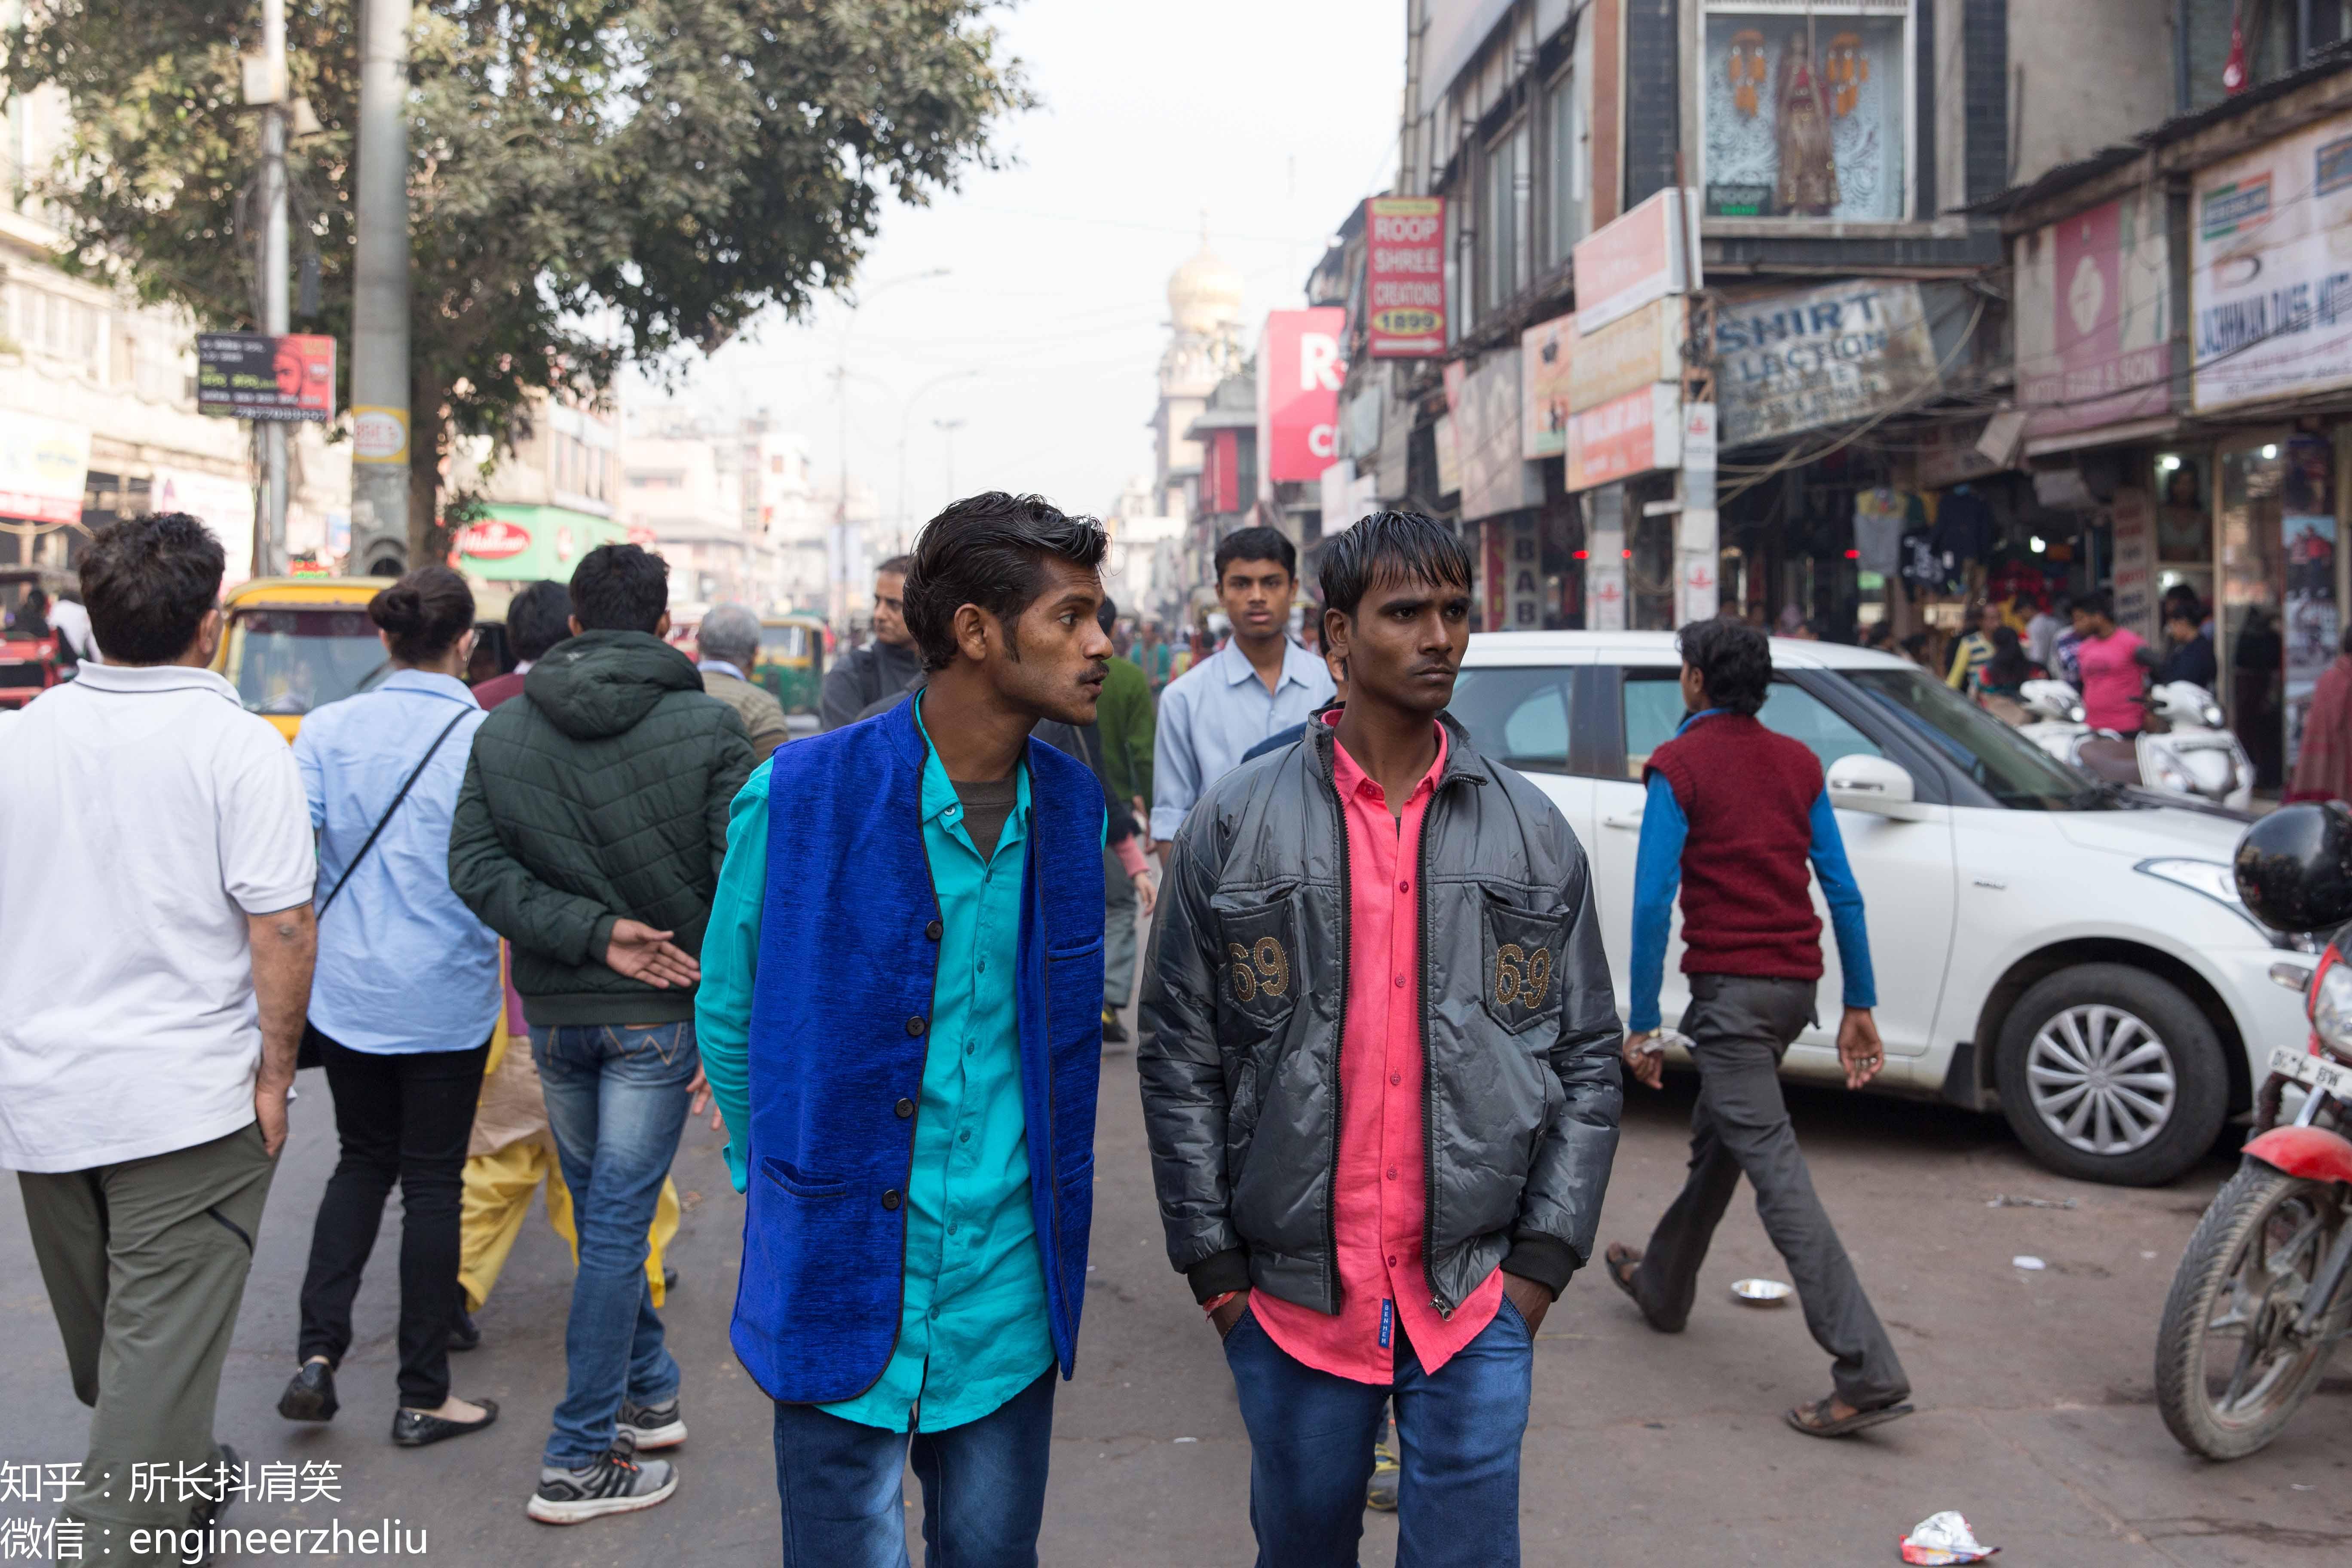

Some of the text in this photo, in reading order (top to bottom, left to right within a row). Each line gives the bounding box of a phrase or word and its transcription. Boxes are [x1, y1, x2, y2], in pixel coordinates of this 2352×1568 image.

[1374, 217, 1439, 242] ROOP
[1374, 247, 1439, 273] SHREE
[1381, 312, 1436, 332] 1899
[1715, 290, 1878, 354] SHIRT
[1301, 333, 1348, 390] R
[1228, 937, 1289, 1002] 69
[1495, 943, 1550, 1009] 69
